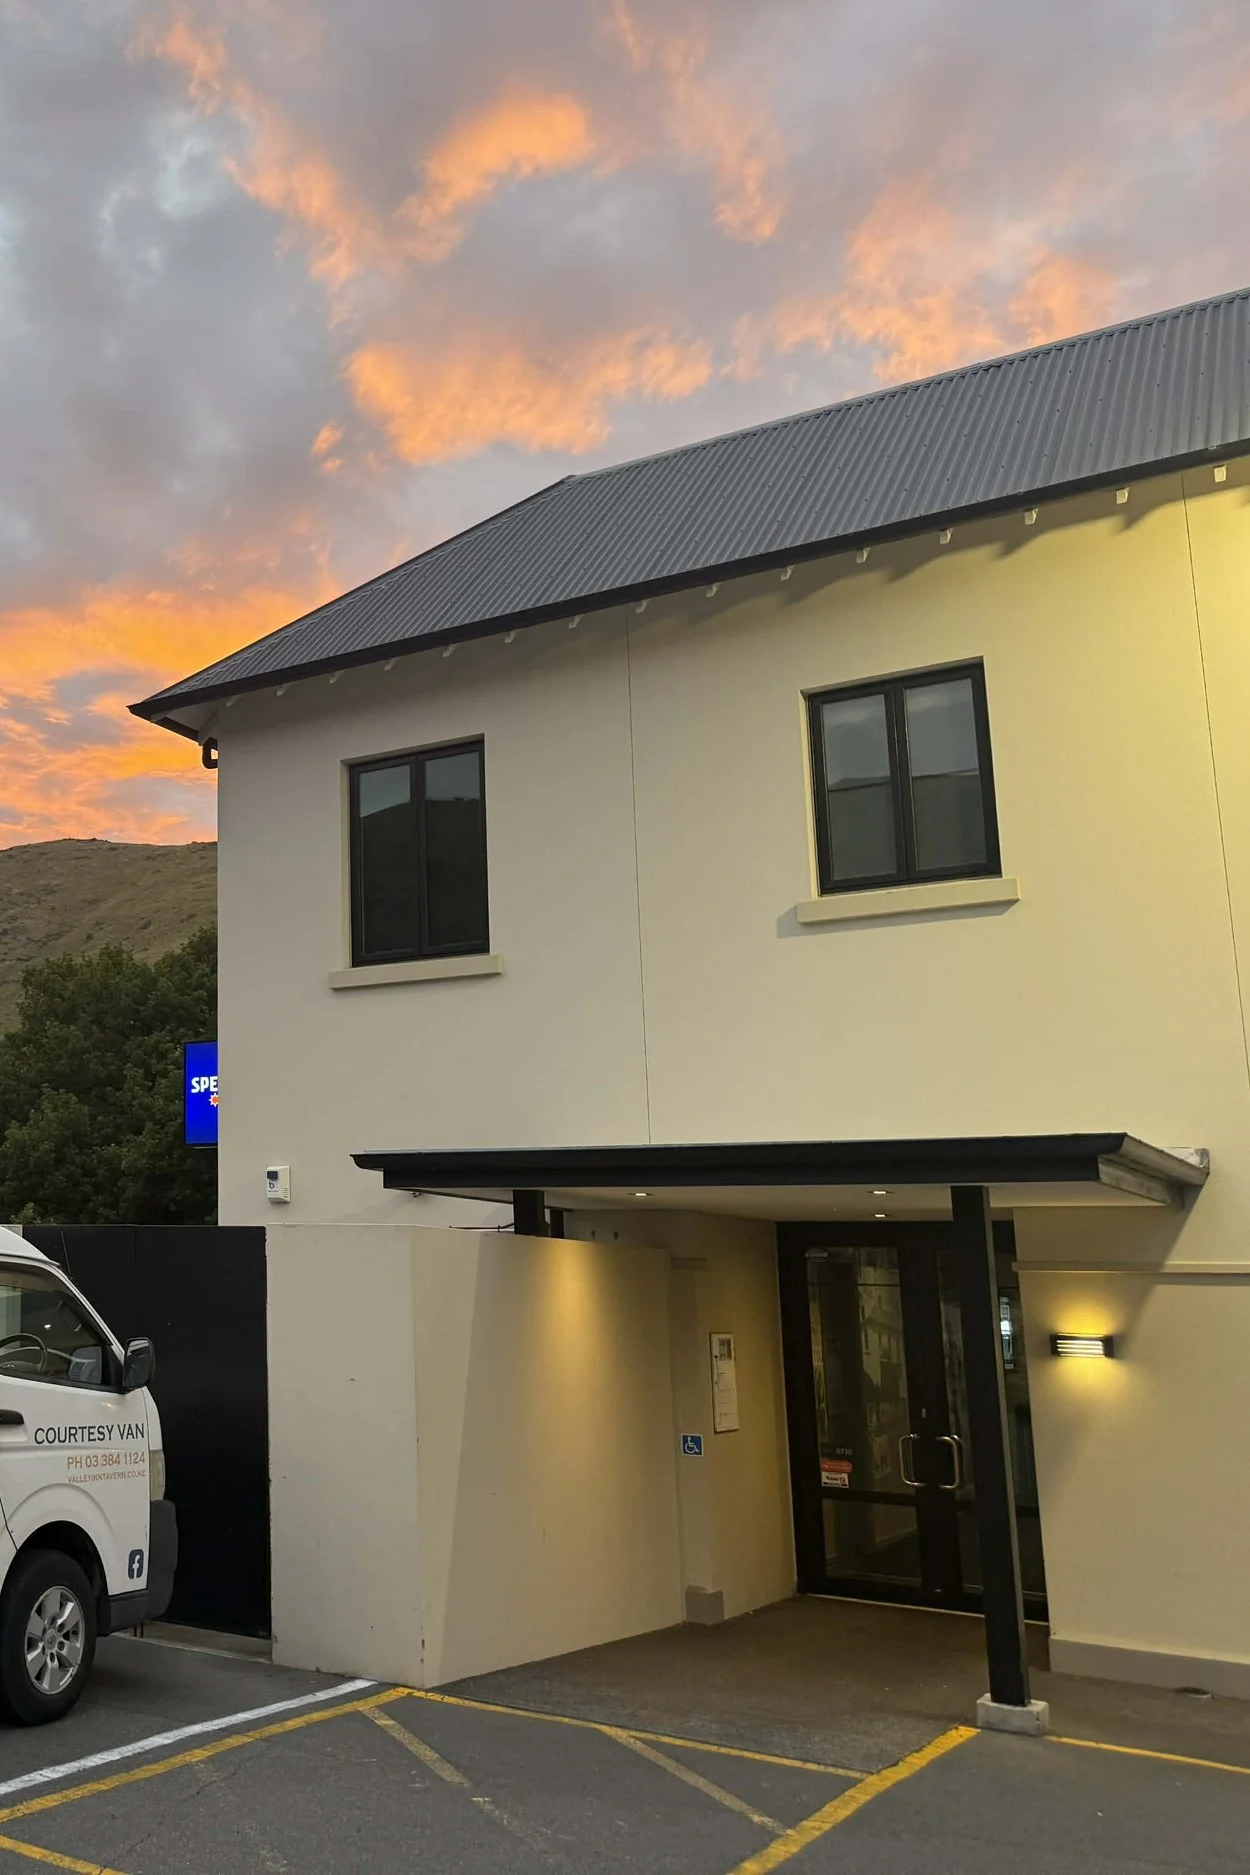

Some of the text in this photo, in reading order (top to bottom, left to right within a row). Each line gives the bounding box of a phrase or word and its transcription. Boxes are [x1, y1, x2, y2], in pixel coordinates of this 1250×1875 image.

[34, 1422, 145, 1444] COURTESY VAN
[67, 1451, 145, 1470] PH 03 384 1124
